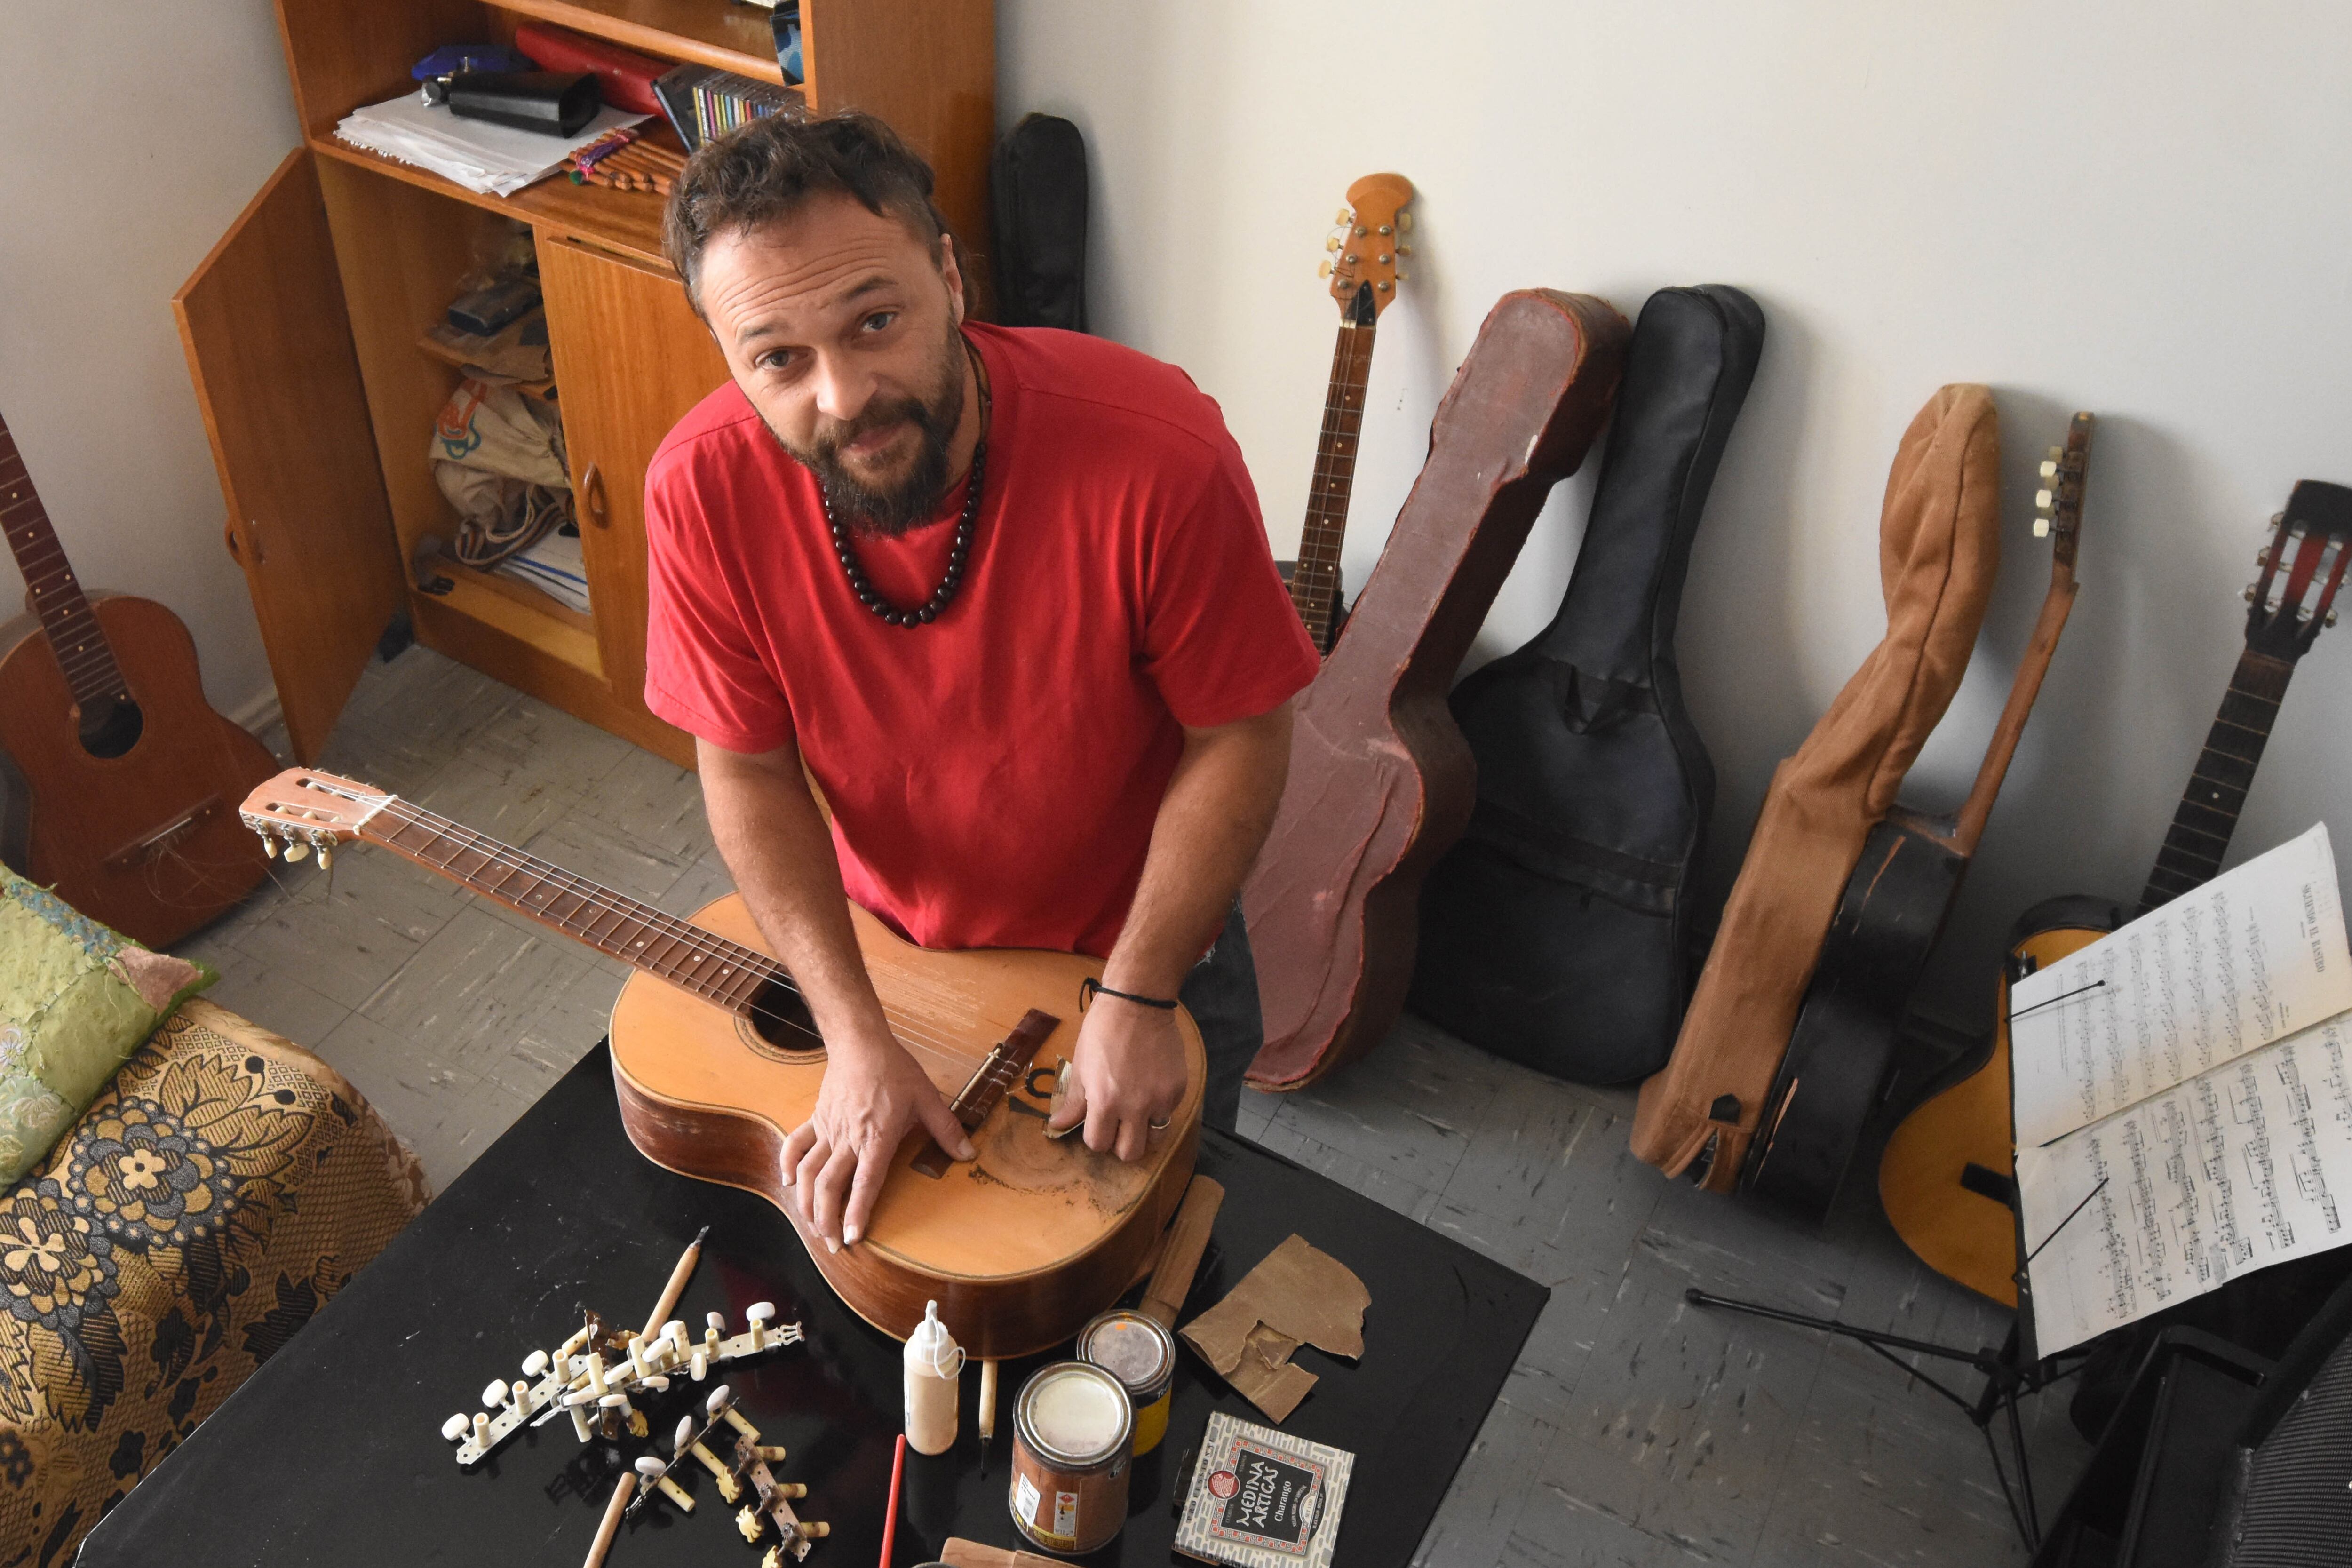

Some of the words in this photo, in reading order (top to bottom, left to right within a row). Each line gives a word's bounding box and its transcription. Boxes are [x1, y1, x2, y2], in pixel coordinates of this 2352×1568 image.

[1187, 1439, 1215, 1521] PROFESSIONAL
[1236, 1461, 1265, 1527] MEDINA
[1252, 1466, 1279, 1528] ARTIGAS
[1274, 1480, 1292, 1522] Charango
